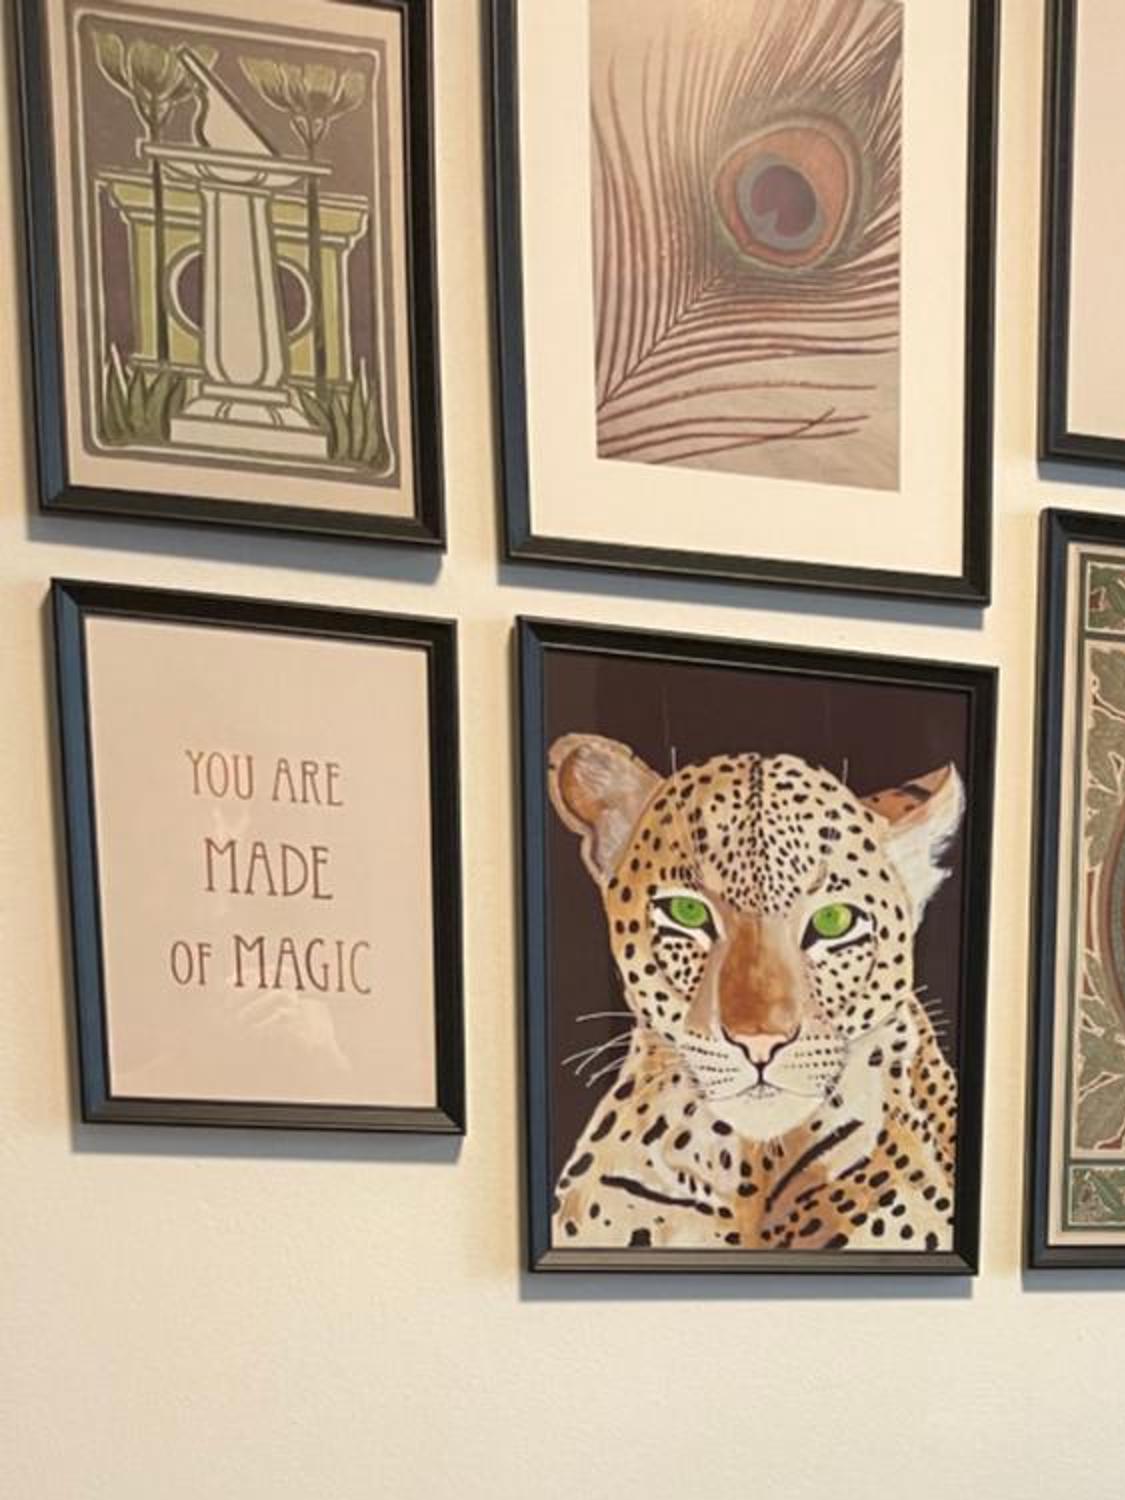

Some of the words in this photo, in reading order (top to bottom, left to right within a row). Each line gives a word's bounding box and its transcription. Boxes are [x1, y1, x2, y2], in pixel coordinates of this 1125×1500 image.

[185, 749, 255, 799] YOU
[272, 757, 344, 807] ARE
[204, 837, 334, 900] MADE
[170, 940, 213, 986] OF
[232, 934, 372, 994] MAGIC
